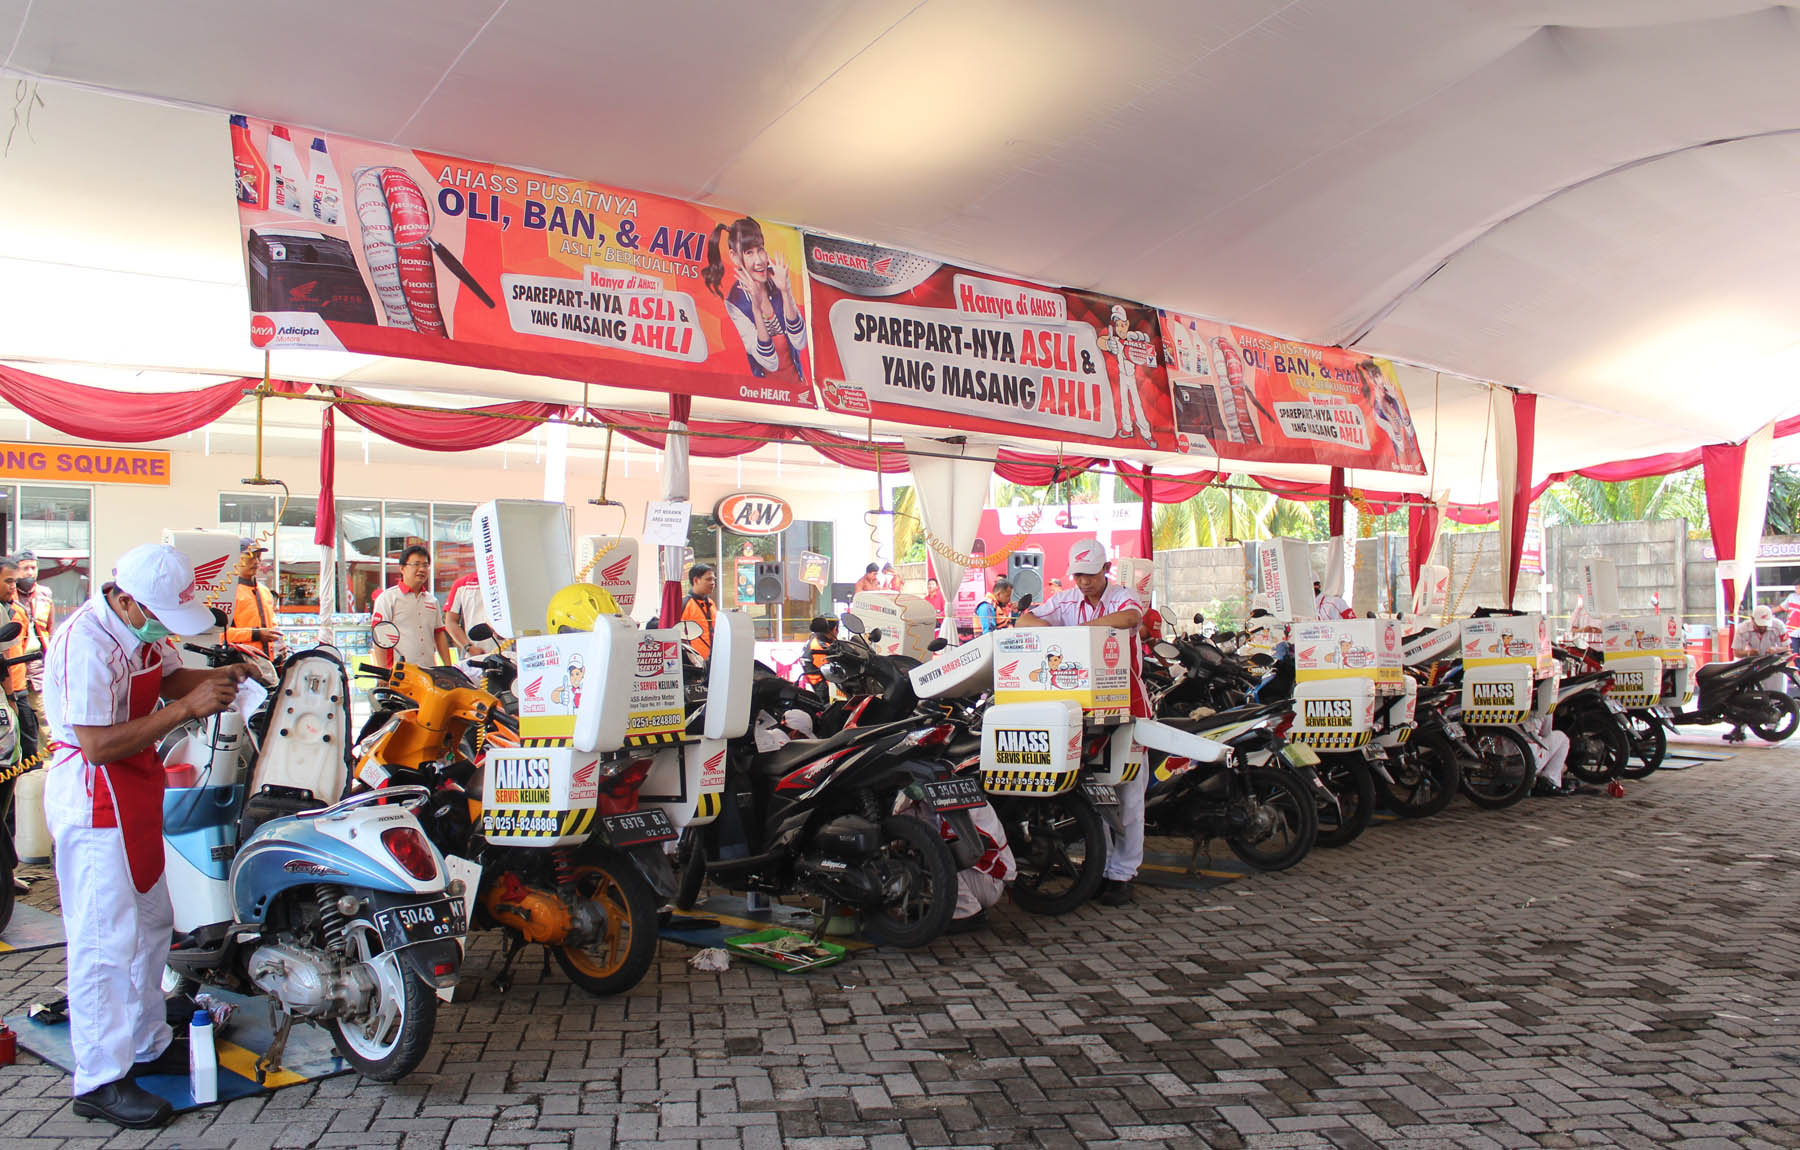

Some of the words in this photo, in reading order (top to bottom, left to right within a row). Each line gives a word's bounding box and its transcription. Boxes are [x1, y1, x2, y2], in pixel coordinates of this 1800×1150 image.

[438, 166, 518, 194] AHASS
[527, 180, 639, 217] PUSATNYA
[438, 187, 511, 232] OLI,
[523, 199, 606, 248] BAN,
[615, 219, 640, 250] &
[649, 226, 706, 262] AKI
[560, 240, 592, 259] ASLI
[604, 246, 699, 280] BERKUALITAS
[814, 248, 835, 264] One
[590, 271, 624, 291] Hanya
[626, 276, 637, 289] di
[512, 284, 624, 316] SPAREPART-NYA
[628, 296, 676, 322] ASLI
[678, 308, 690, 323] &
[960, 283, 1013, 319] Hanya
[1016, 292, 1028, 314] di
[1030, 296, 1057, 318] AHASS
[277, 326, 319, 337] Adicipta
[530, 309, 558, 328] YANG
[561, 312, 627, 342] MASANG
[631, 323, 694, 355] AHLI
[854, 312, 1016, 364] SPAREPART-NYA
[1019, 329, 1077, 373] ASLI
[1081, 349, 1097, 375] &
[1240, 335, 1272, 351] AHASS
[1274, 341, 1323, 361] PUSATNYA
[1243, 349, 1271, 376] OLI,
[1274, 355, 1315, 380] BAN,
[739, 385, 759, 399] One
[882, 355, 936, 393] YANG
[942, 365, 1037, 410] MASANG
[1037, 376, 1102, 423] AHLI
[1334, 409, 1354, 425] ASLI
[1339, 426, 1364, 446] AHLI
[0, 451, 47, 471] NG
[56, 453, 165, 476] SQUARE
[481, 516, 493, 554] KELILING
[485, 554, 497, 586] SERVIS
[941, 658, 961, 675] SERVIS
[640, 681, 657, 691] SERVIS
[658, 680, 679, 690] KELILING
[918, 668, 942, 686] KELILING
[1475, 684, 1513, 698] AHASS
[1306, 701, 1351, 717] AHASS
[632, 714, 681, 728] 0251-8248809
[1305, 718, 1326, 727] SERVIS
[1327, 718, 1353, 727] KELILING
[998, 731, 1049, 752] AHASS
[996, 752, 1020, 764] SERVIS
[1021, 753, 1051, 765] KELILING
[496, 759, 550, 789] AHASS
[496, 790, 519, 803] SERVIS
[520, 790, 550, 803] KELILING
[495, 816, 558, 832] 0251-8248809
[606, 820, 615, 832] F
[619, 817, 646, 830] 6979
[378, 914, 390, 933] F
[400, 906, 435, 926] 5048
[449, 899, 465, 918] NT
